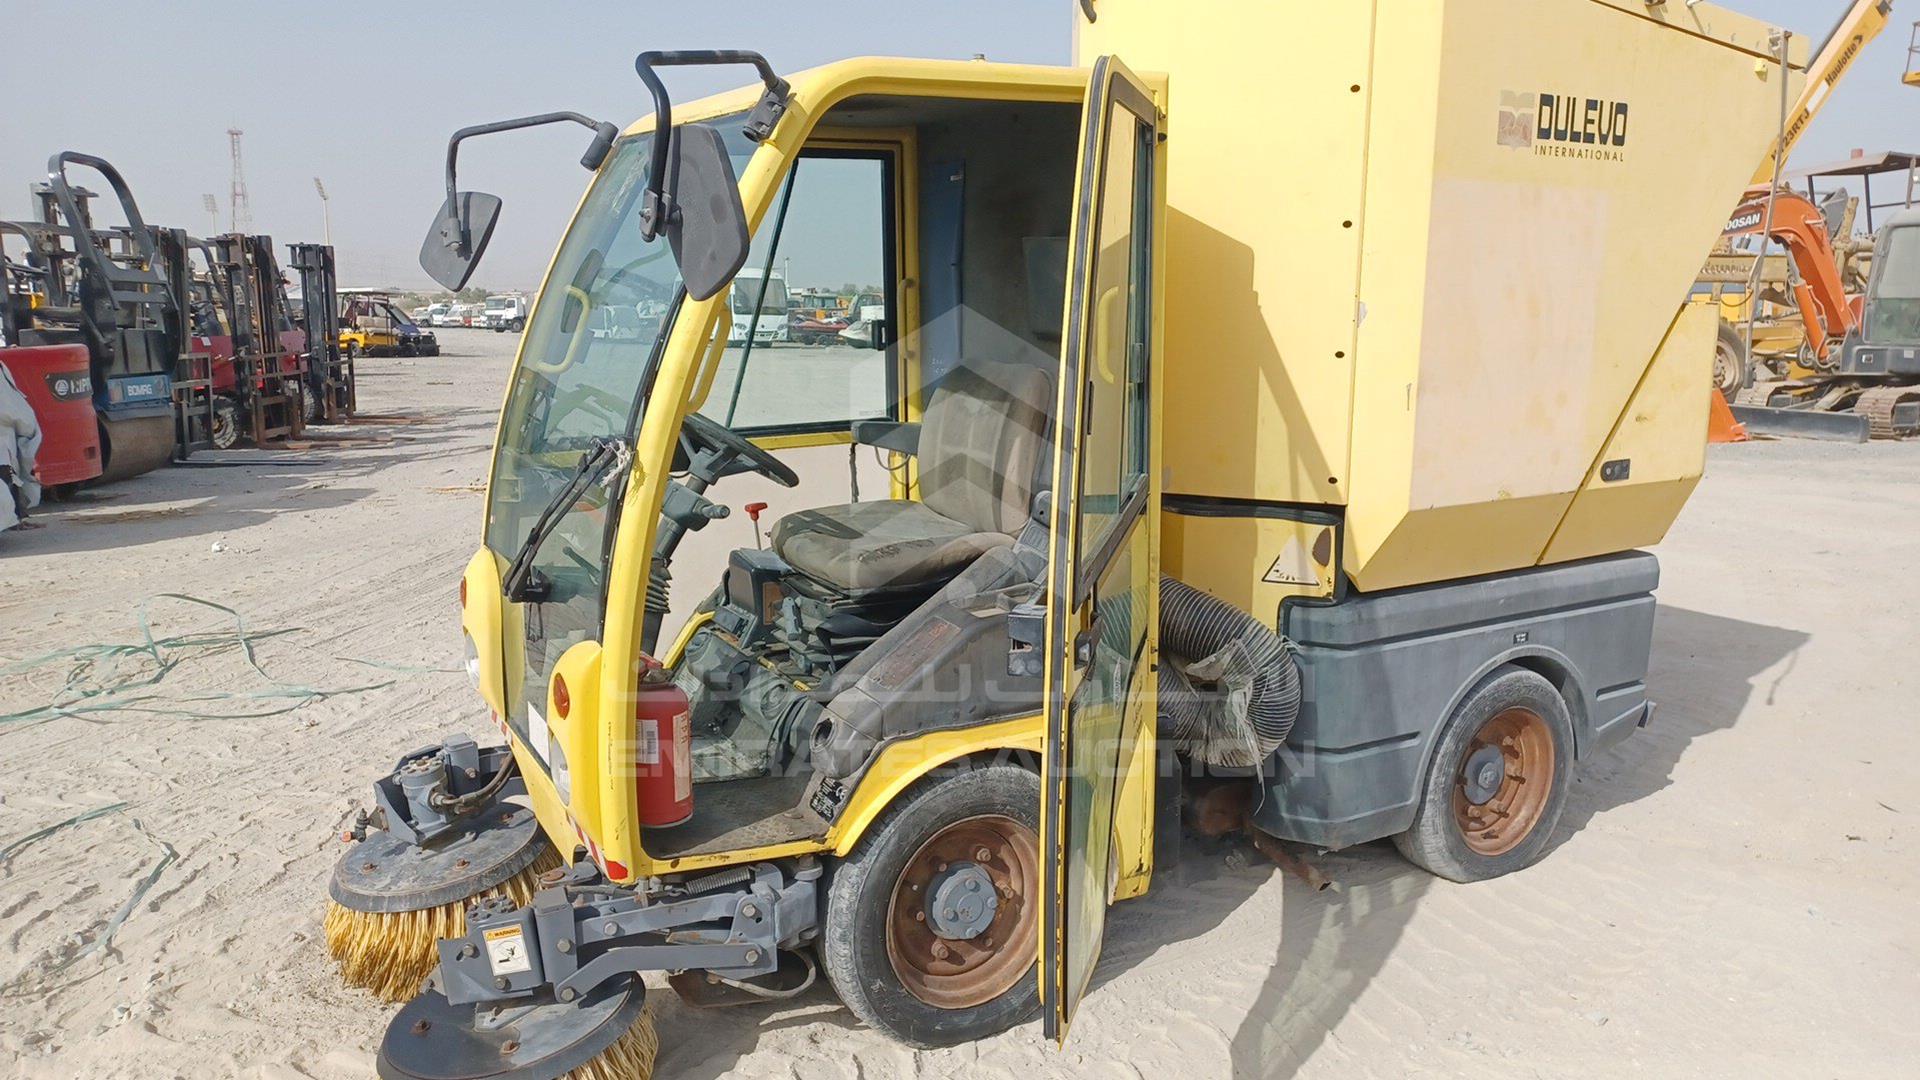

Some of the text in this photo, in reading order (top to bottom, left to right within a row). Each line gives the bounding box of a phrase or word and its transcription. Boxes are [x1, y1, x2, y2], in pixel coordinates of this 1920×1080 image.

[1824, 44, 1858, 87] Haulotte
[1537, 92, 1628, 147] DULEVO
[1534, 144, 1624, 162] INTERNATIONAL
[127, 384, 153, 396] BOMAG
